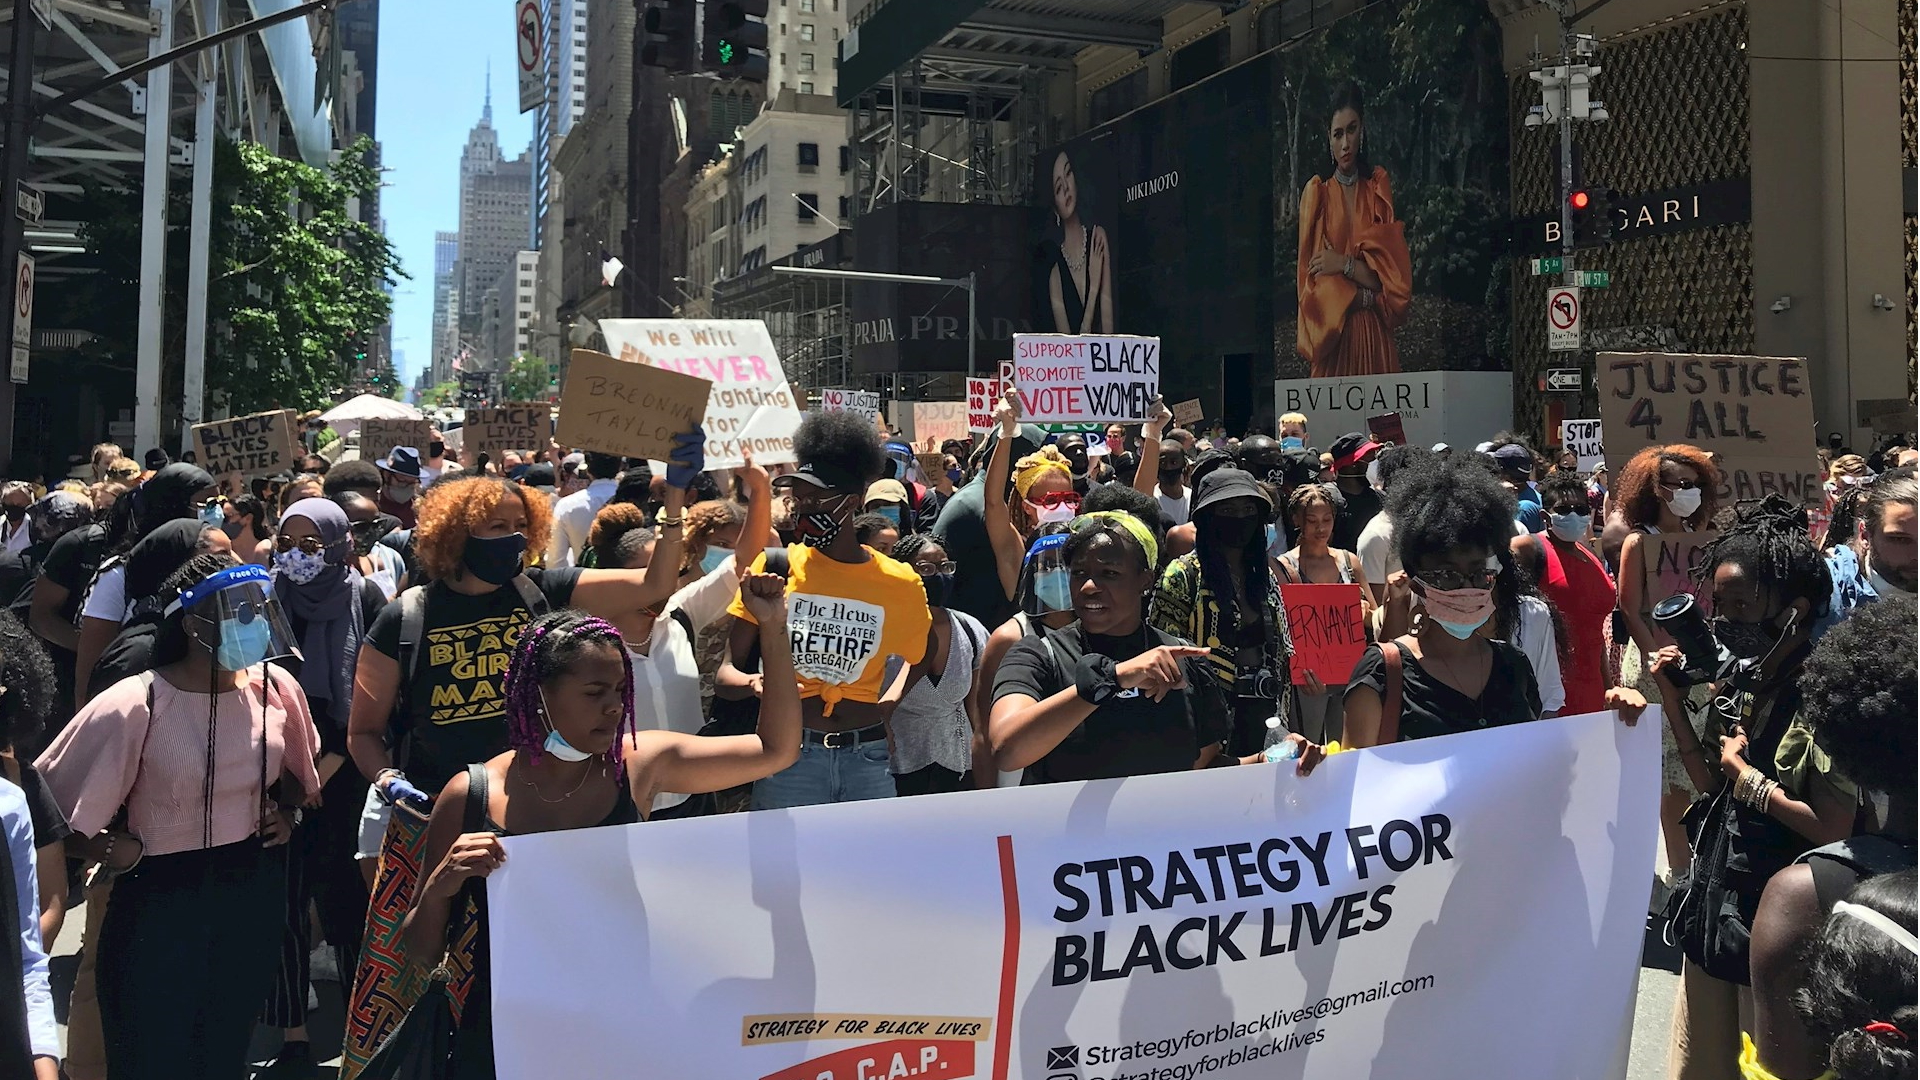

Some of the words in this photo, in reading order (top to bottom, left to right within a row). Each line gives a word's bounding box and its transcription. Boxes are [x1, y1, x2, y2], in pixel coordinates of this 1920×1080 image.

[1126, 170, 1179, 203] MIKIMOTO
[1545, 195, 1699, 243] BGARI
[803, 248, 824, 268] PRADA
[1544, 260, 1550, 273] 5
[1584, 273, 1591, 285] W
[1593, 273, 1601, 285] 57
[646, 329, 681, 347] We
[691, 327, 737, 347] Will
[854, 317, 895, 346] PRADA
[1018, 341, 1086, 358] SUPPORT
[1089, 342, 1157, 375] BLACK
[1017, 366, 1086, 381] PROMOTE
[1552, 375, 1566, 384] ONE
[1571, 376, 1580, 384] WA
[1608, 357, 1806, 399] JUSTICE
[585, 375, 695, 423] BREONNA
[707, 387, 790, 409] ighting
[824, 391, 843, 405] NO
[969, 380, 985, 396] NO
[1286, 382, 1430, 411] BVLGARI
[969, 397, 984, 411] NO
[1018, 386, 1084, 416] VOTE
[1084, 381, 1156, 419] WOMEN
[468, 408, 543, 427] BLACK
[706, 416, 740, 434] for
[1399, 410, 1420, 419] OMA
[1625, 396, 1663, 441] 4
[1684, 399, 1767, 441] ALL
[200, 415, 275, 445] BLACK
[366, 420, 425, 435] BLACK
[487, 425, 537, 439] LIVES
[1567, 421, 1601, 442] STOP
[205, 436, 269, 459] LIVES
[738, 436, 796, 455] Wome
[206, 451, 280, 476] MATTER
[1041, 539, 1058, 547] Face
[229, 569, 251, 580] Face
[794, 597, 826, 618] The
[828, 602, 878, 626] News
[792, 619, 806, 630] 65
[808, 620, 841, 635] YEARS
[844, 626, 876, 641] LATER
[429, 624, 529, 667] BLAC
[450, 652, 511, 680] GIR
[1052, 830, 1333, 923] STRATEGY
[1345, 812, 1455, 880] FOR
[1051, 909, 1249, 987] BLACK
[1259, 884, 1396, 958] LIVES
[747, 1019, 829, 1039] STRATEGY
[834, 1019, 870, 1034] FOR
[873, 1020, 930, 1036] BLACK
[934, 1022, 982, 1036] LIVES
[1085, 972, 1436, 1066] Strategyforblacklives@gmail.com
